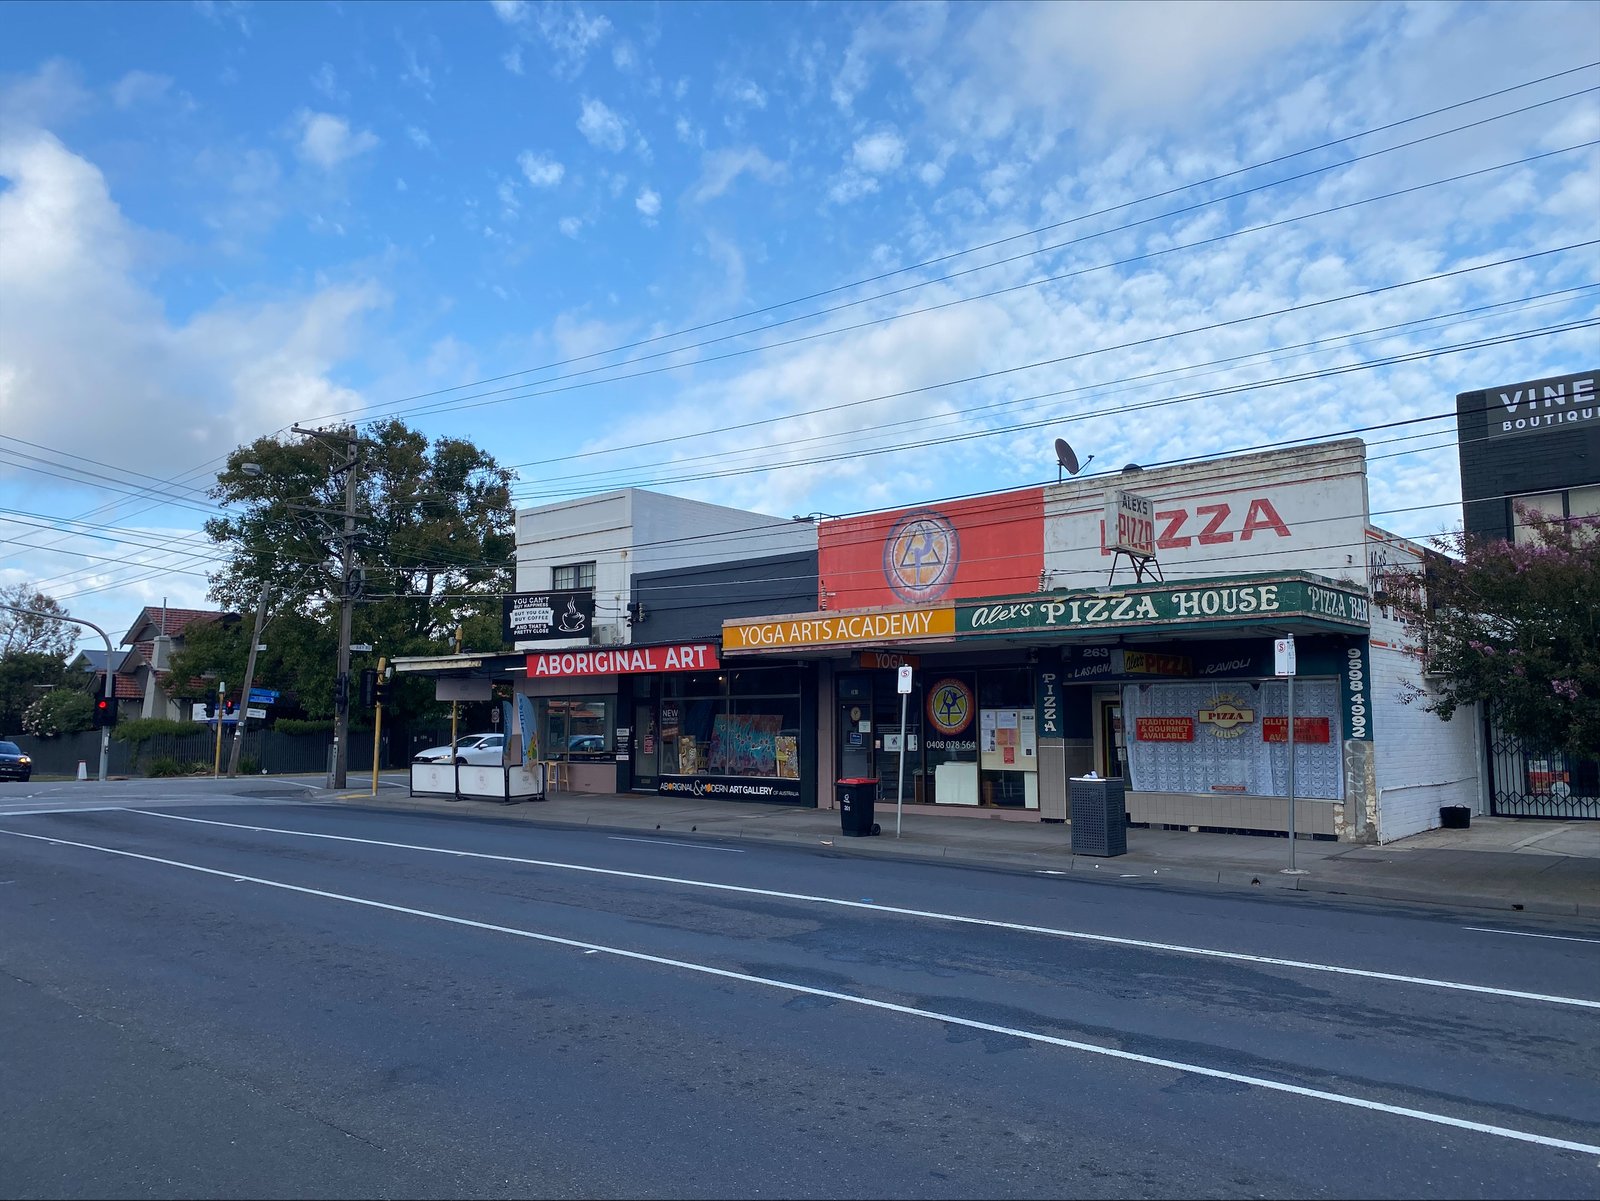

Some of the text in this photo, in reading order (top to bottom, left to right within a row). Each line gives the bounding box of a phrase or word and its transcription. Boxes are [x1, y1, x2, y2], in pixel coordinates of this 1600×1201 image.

[1500, 379, 1595, 413] VINE
[1503, 406, 1600, 431] BOUTIQU
[1118, 513, 1153, 551] PIZZA
[529, 596, 550, 604] CAN'T
[971, 585, 1280, 628] Alex's PIZZA HOUSE
[1307, 586, 1347, 617] PIZZA
[1349, 596, 1369, 622] BAR
[739, 611, 934, 645] YOGA ARTS ACADEMY
[1082, 647, 1109, 657] 263
[535, 645, 707, 676] ABORIGINAL ART
[875, 653, 906, 669] YOGA
[1206, 658, 1251, 674] RAVIOLI
[1042, 673, 1057, 732] PIZZA
[662, 709, 679, 717] NEW
[1208, 712, 1244, 720] PIZZA
[1137, 718, 1193, 726] TRADITIONAL
[1264, 718, 1301, 726] GLUTN
[1148, 725, 1189, 733] GOURMET
[1206, 727, 1247, 739] HOUSE
[1142, 732, 1188, 740] AVAILABLE
[926, 740, 976, 749] 0408 078 564
[660, 782, 694, 792] ABORIGINAL
[701, 782, 729, 793] MODERN
[729, 785, 743, 794] ART
[743, 785, 774, 795] GALLERY
